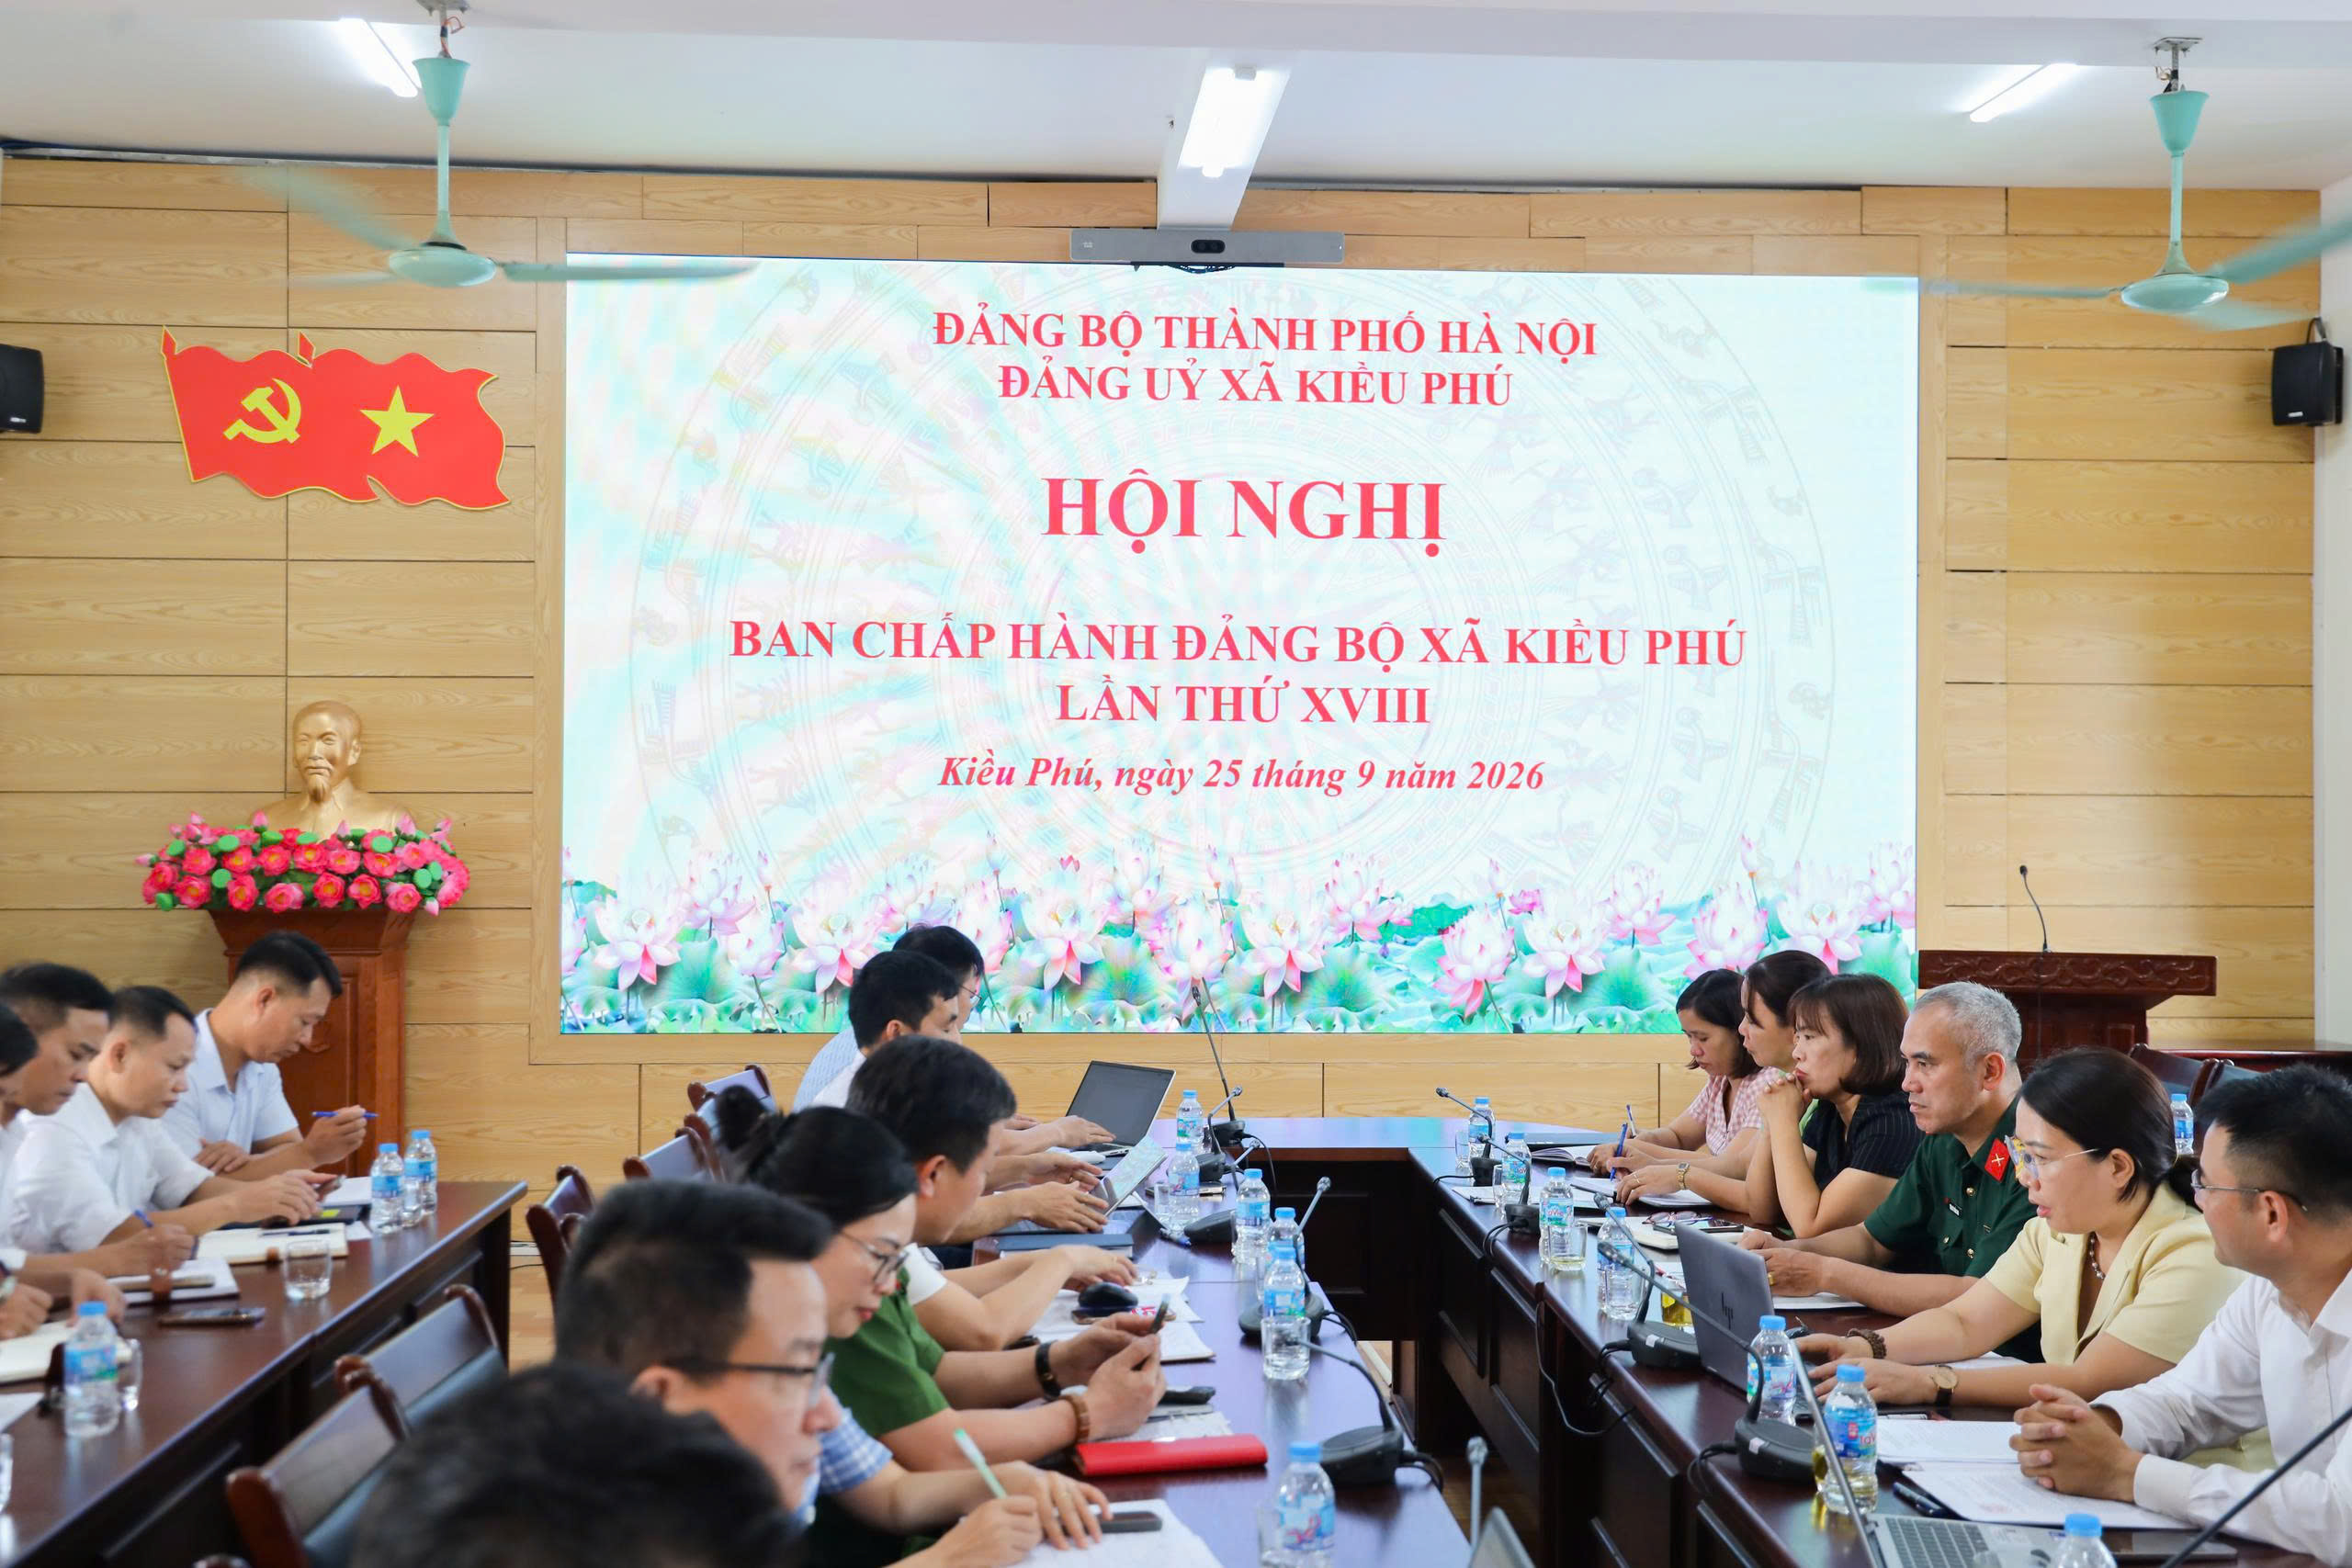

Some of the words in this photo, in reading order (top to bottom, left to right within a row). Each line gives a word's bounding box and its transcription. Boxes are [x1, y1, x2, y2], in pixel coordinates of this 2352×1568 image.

[933, 301, 1065, 347] ĐẢNG
[1080, 310, 1144, 357] BỘ
[1154, 307, 1317, 351] THÀNH
[1330, 310, 1427, 354] PHỐ
[1439, 311, 1503, 355] HÀ
[1516, 318, 1597, 365] NỘI
[999, 355, 1130, 400] ĐẢNG
[1144, 357, 1206, 401] UỶ
[1219, 360, 1283, 402] XÃ
[1295, 361, 1408, 405] KIỀU
[1421, 364, 1512, 406] PHÚ
[1042, 468, 1202, 554] HỘI
[1227, 479, 1446, 558] NGHỊ
[729, 621, 835, 658] BAN
[853, 612, 996, 659] CHẤP
[1009, 613, 1158, 660] HÀNH
[1172, 613, 1321, 662] ĐẢNG
[1334, 621, 1406, 673] BỘ
[1419, 616, 1489, 663] XÃ
[1504, 619, 1631, 665] KIỀU
[1644, 618, 1747, 667] PHÚ
[1056, 674, 1160, 721] LẦN
[1174, 674, 1291, 723] THỨ
[1299, 687, 1430, 724] XVIII
[938, 749, 1015, 786] Kiều
[1025, 756, 1102, 791] Phú,
[1114, 759, 1193, 795] ngày
[1204, 759, 1244, 787] 25
[1252, 759, 1347, 796] tháng
[1358, 761, 1376, 788] 9
[1385, 761, 1457, 790] năm
[1467, 761, 1545, 790] 2026
